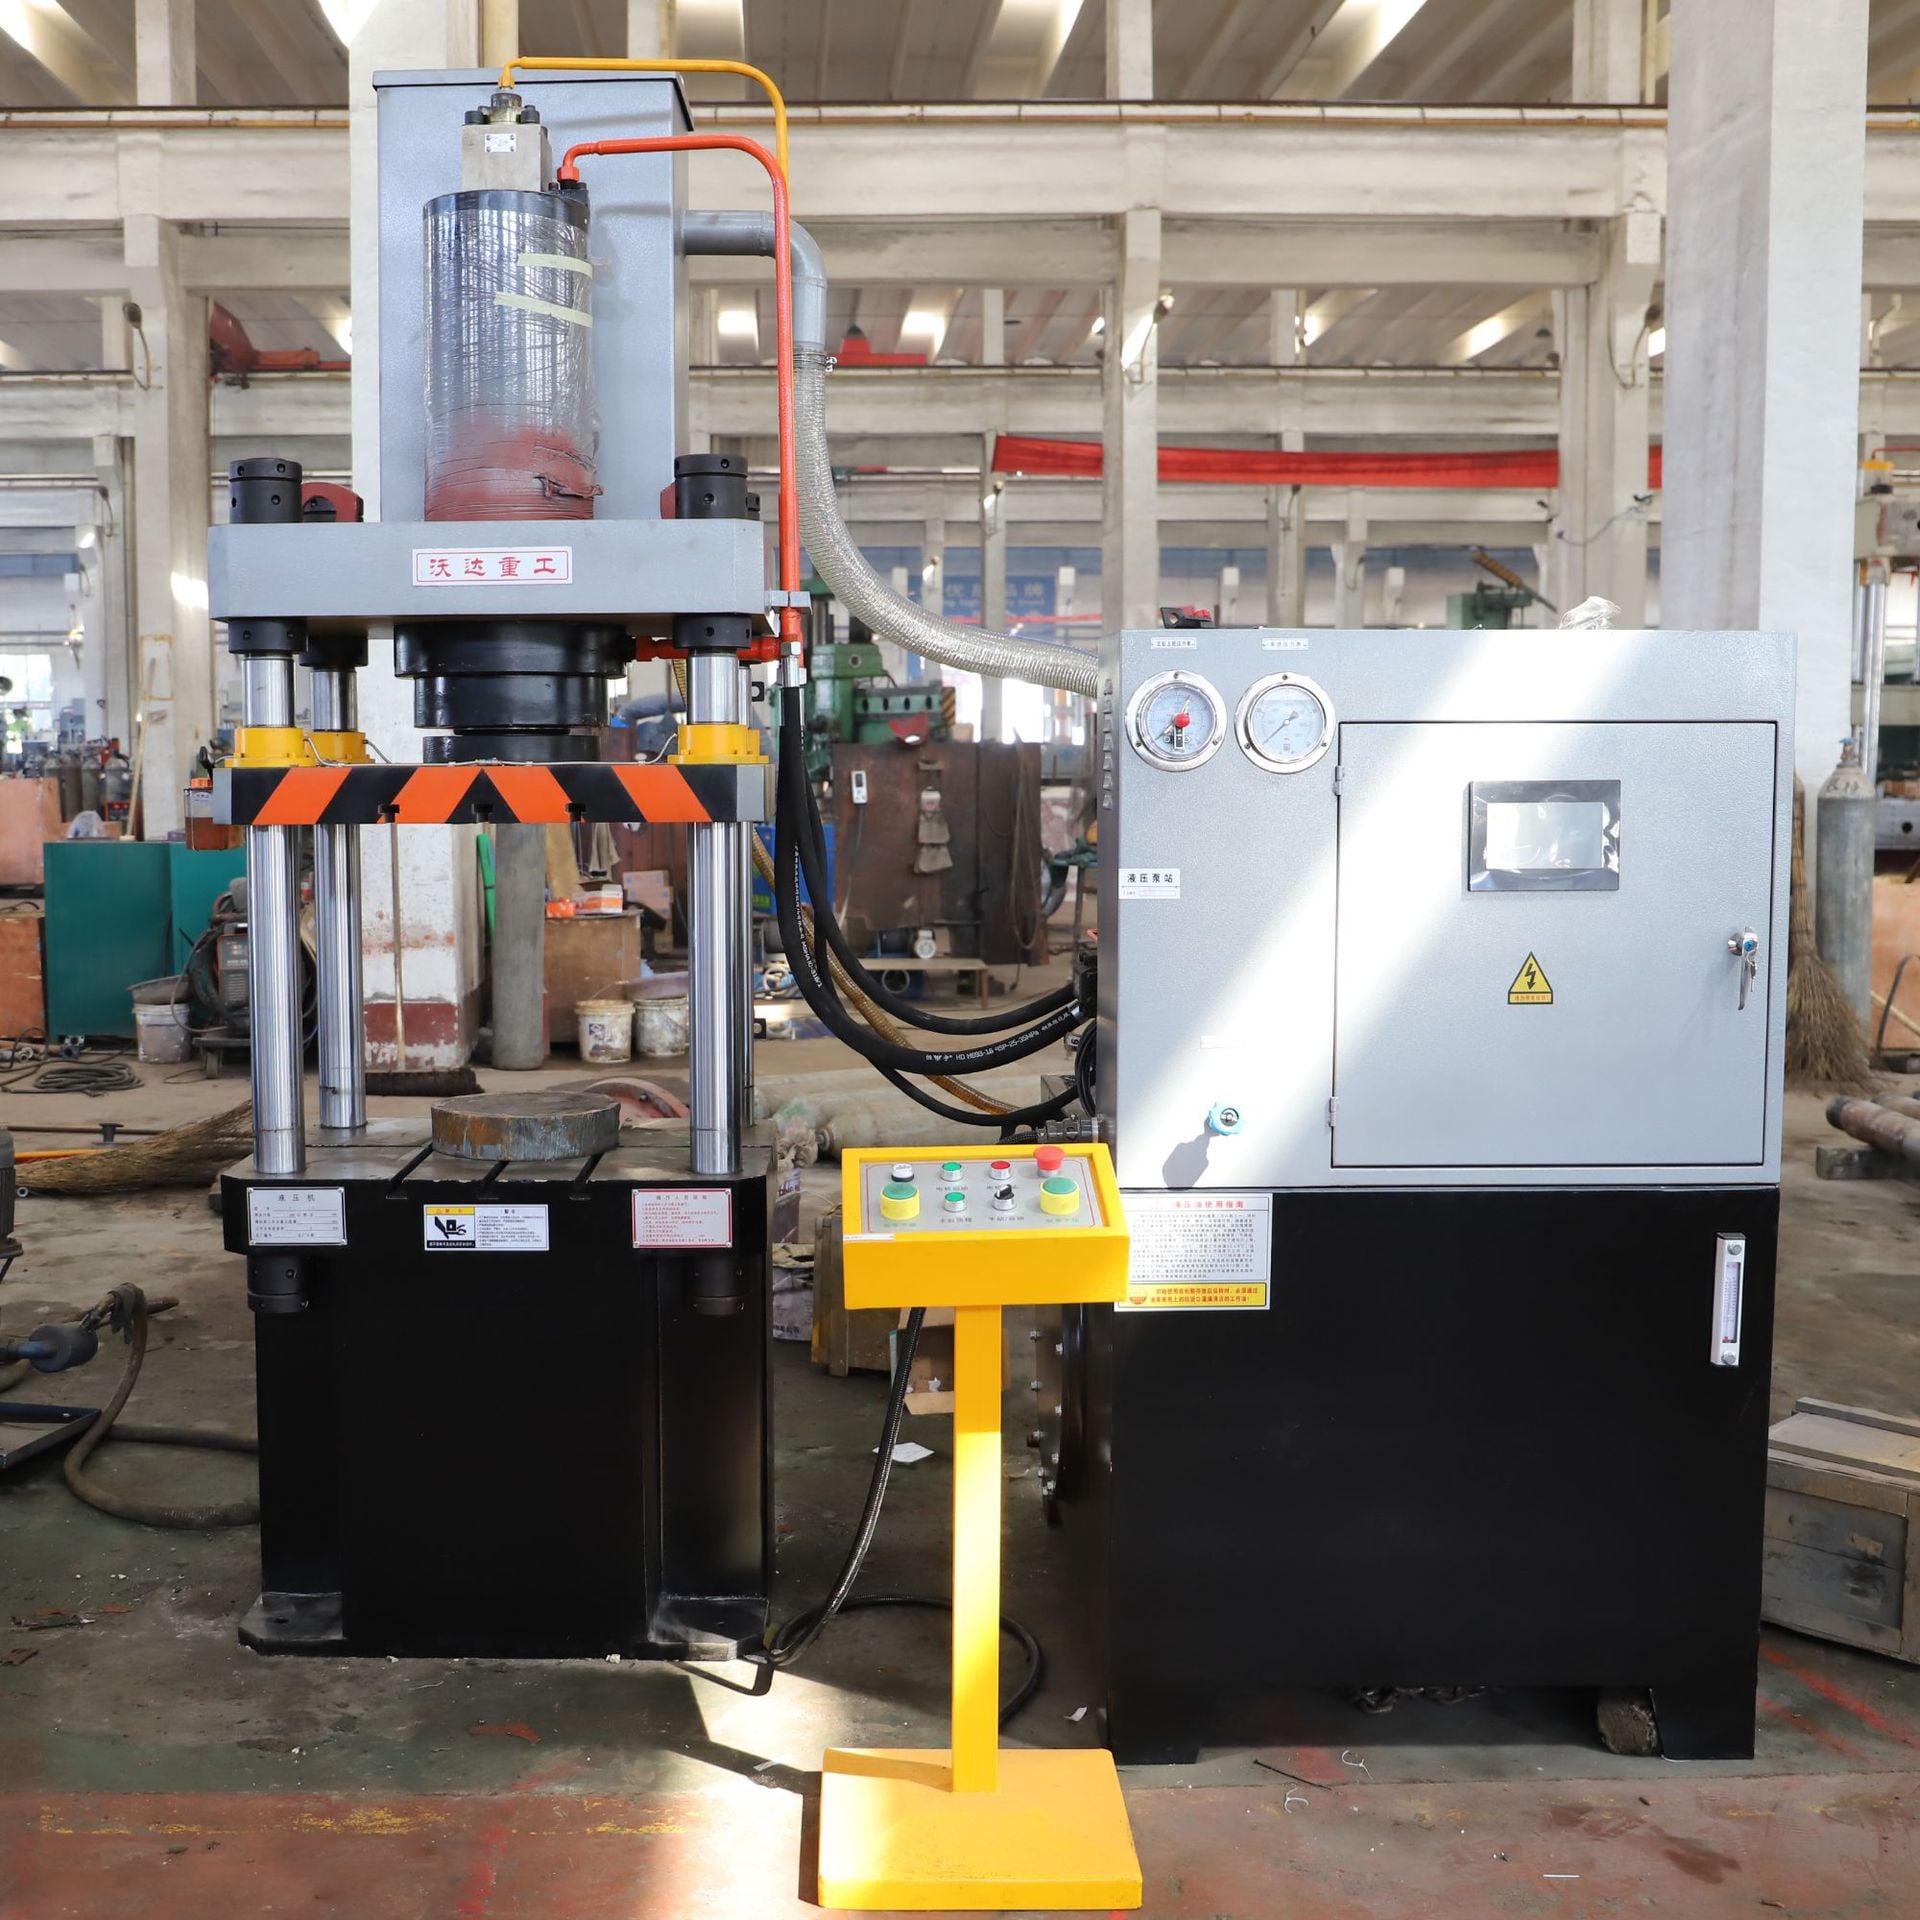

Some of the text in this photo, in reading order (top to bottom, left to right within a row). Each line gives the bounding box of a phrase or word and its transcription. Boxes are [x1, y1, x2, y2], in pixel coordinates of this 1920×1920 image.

[429, 556, 556, 577] 沃达重工
[1127, 873, 1173, 883] 液压泵站
[278, 1194, 316, 1202] 液压机
